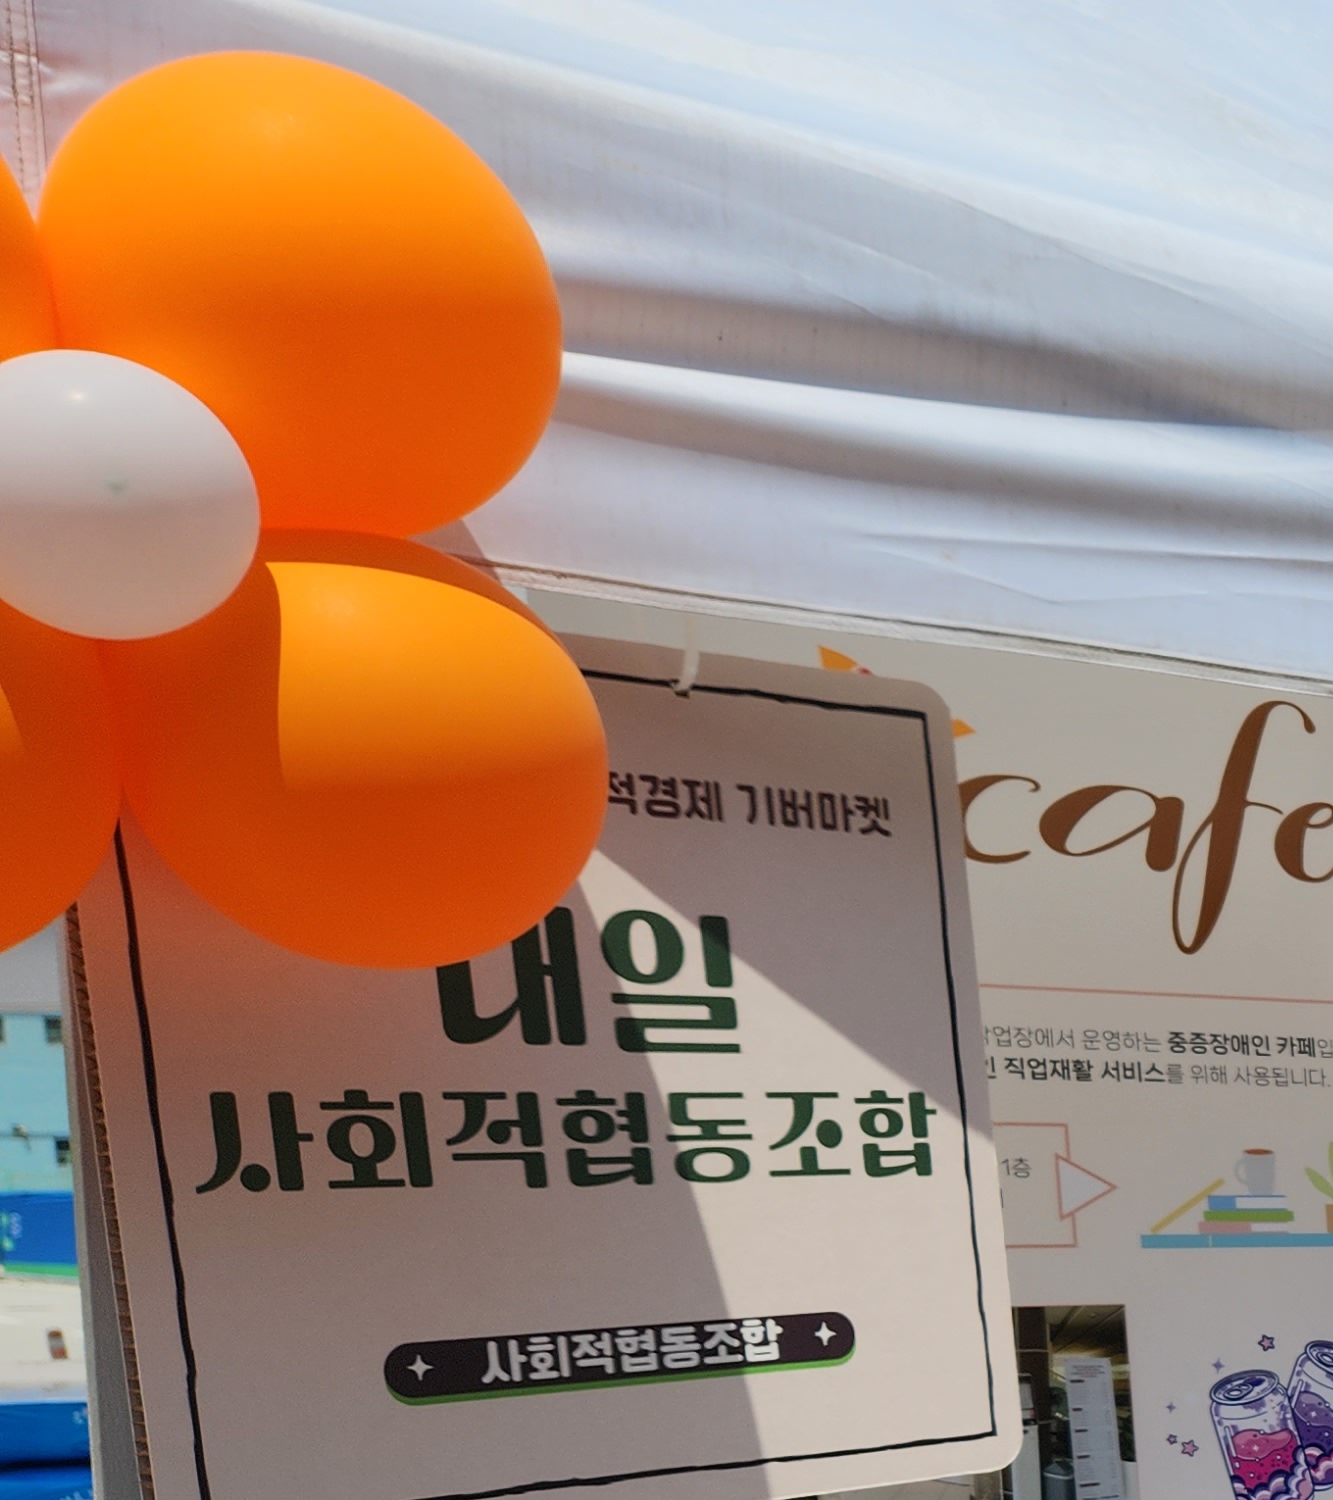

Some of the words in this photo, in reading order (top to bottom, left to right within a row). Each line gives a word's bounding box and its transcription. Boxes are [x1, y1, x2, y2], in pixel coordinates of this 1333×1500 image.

[608, 771, 725, 822] 적경제
[736, 784, 891, 838] 기버마켓
[437, 907, 741, 1053] 내일
[1004, 1058, 1093, 1083] 직업재활
[1102, 1060, 1184, 1085] 서비스를
[1191, 1065, 1227, 1085] 위해
[1233, 1065, 1331, 1087] 사용됩니다.
[1082, 1029, 1161, 1052] 운영하는
[1168, 1032, 1271, 1057] 중증장애인
[197, 1090, 936, 1194] 사회적협동조합
[482, 1319, 782, 1387] 사회적협동조합
